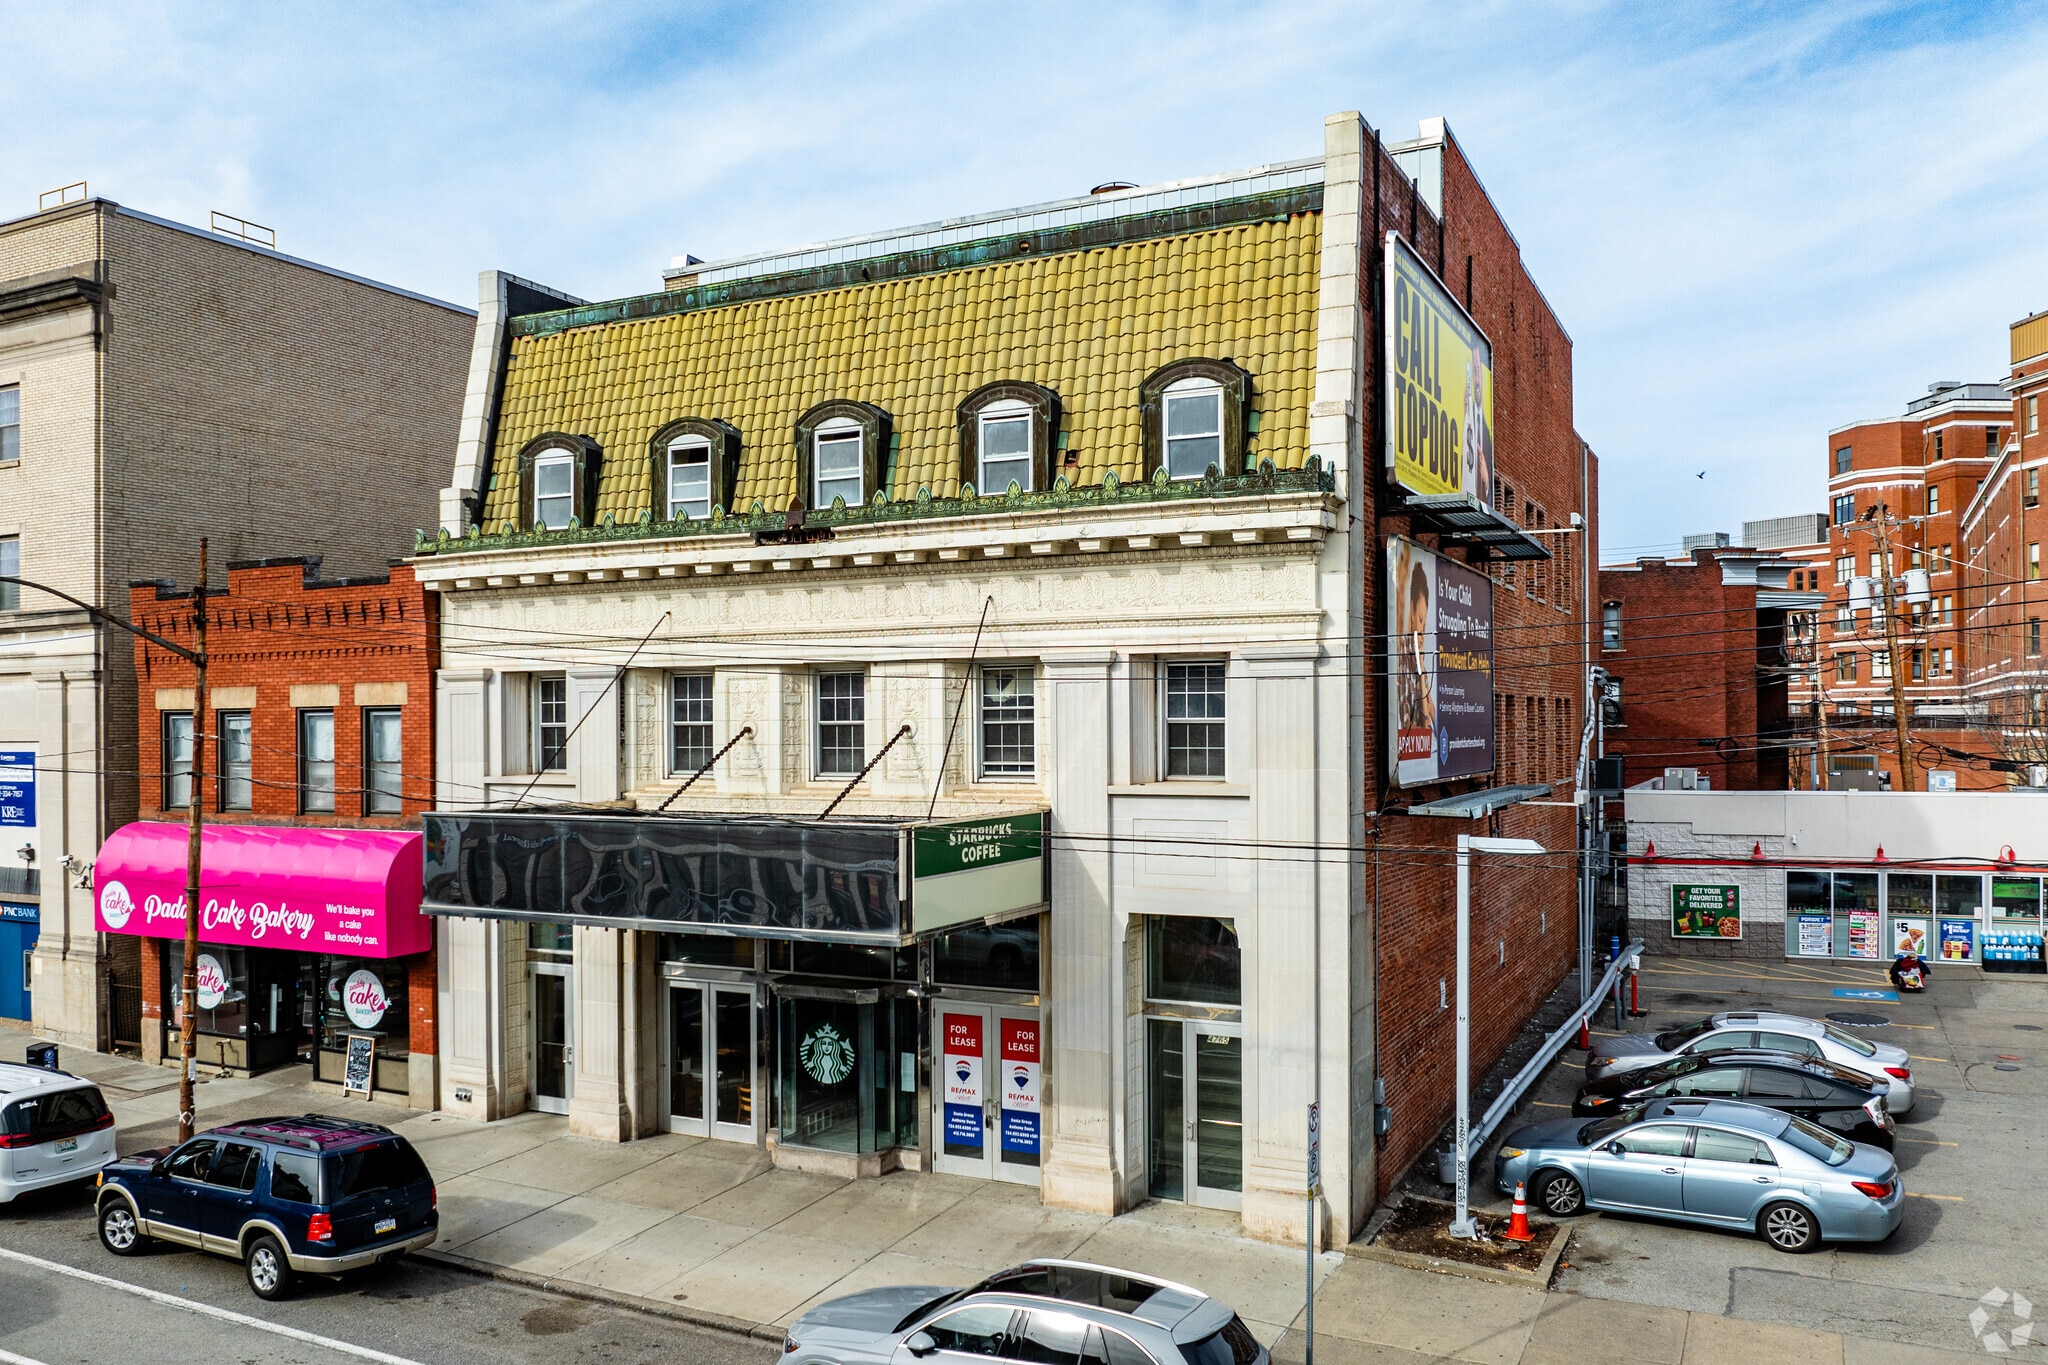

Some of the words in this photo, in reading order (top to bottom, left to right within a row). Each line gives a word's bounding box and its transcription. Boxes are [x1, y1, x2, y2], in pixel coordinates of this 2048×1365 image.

[1395, 276, 1442, 403] CALL
[1395, 372, 1459, 490] TOPDOG
[1438, 576, 1444, 597] Is
[1444, 579, 1457, 602] Your
[1458, 582, 1472, 607] Child
[1438, 607, 1467, 640] Struggling
[1467, 616, 1474, 636] To
[1439, 645, 1466, 671] Provident
[1467, 650, 1478, 671] Can
[1398, 735, 1413, 754] APPLY
[1414, 735, 1431, 753] NOW!
[949, 822, 1012, 846] STARBUCKS
[961, 842, 1001, 863] COFFEE
[105, 892, 127, 915] cake
[1689, 894, 1723, 902] FAVORITES
[1689, 901, 1723, 909] DELIVERED
[4, 906, 17, 917] PNC
[17, 908, 37, 918] BANK
[326, 903, 343, 914] We'll
[343, 905, 360, 915] bake
[361, 908, 375, 918] you
[203, 898, 247, 931] Cake
[249, 902, 315, 940] Bakery
[344, 920, 362, 930] cake
[1896, 922, 1909, 933] $5
[324, 931, 336, 941] like
[337, 934, 363, 946] nobody
[363, 936, 379, 945] can.
[199, 966, 220, 994] ake
[348, 980, 365, 993] paddy
[349, 983, 381, 1013] cake
[355, 1007, 373, 1016] BAKERY
[951, 1025, 968, 1035] FOR
[1017, 1031, 1035, 1041] FOR
[951, 1037, 976, 1048] LEASE
[1208, 1035, 1230, 1044] 4765
[1008, 1042, 1035, 1053] LEASE
[951, 1087, 976, 1096] RE/MAX
[1009, 1094, 1035, 1102] RE/MAX
